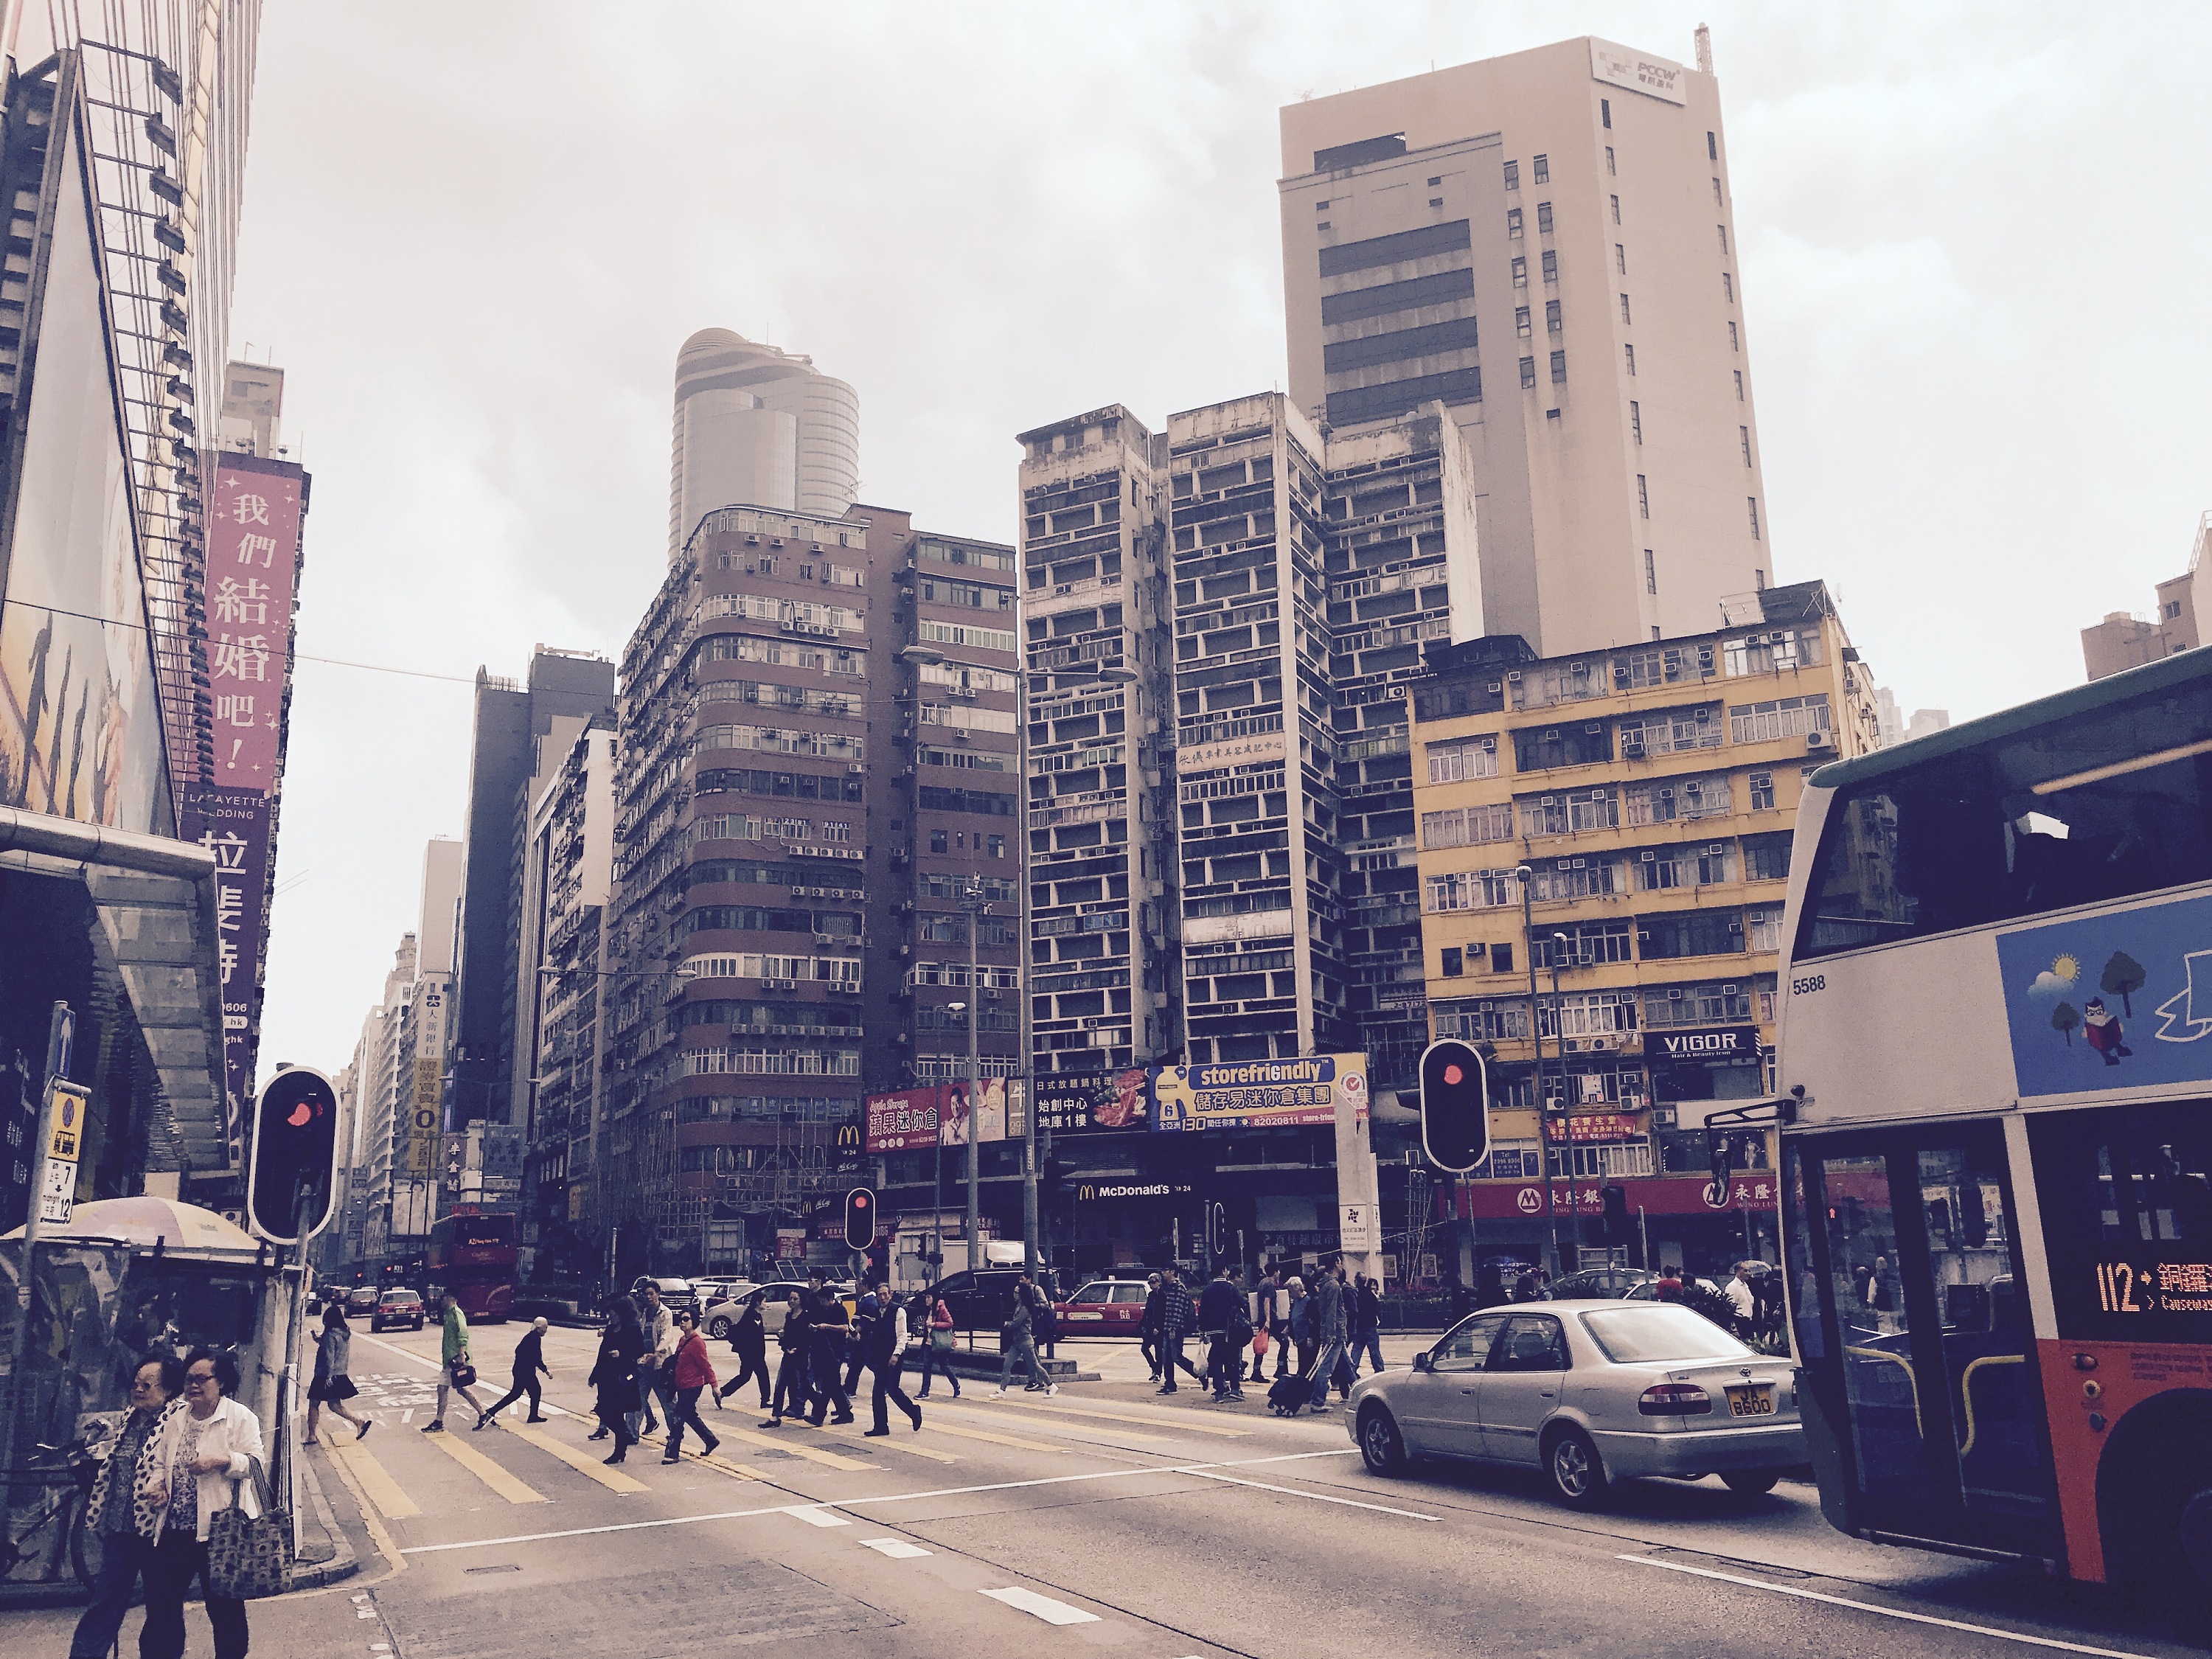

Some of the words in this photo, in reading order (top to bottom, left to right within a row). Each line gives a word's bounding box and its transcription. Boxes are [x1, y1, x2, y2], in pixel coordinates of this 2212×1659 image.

[1638, 62, 1676, 80] PCCW
[1793, 975, 1826, 995] 5588
[1663, 1033, 1737, 1052] VIGOR
[1037, 1077, 1113, 1091] 日式放題鍋料理
[1038, 1097, 1088, 1113] 始創中心
[1195, 1087, 1329, 1111] 儲存易迷你倉集團
[869, 1107, 938, 1137] 蘋果迷你倉
[1182, 1116, 1207, 1132] 130
[1253, 1116, 1298, 1126] 82020811
[65, 1166, 71, 1184] 7
[1099, 1184, 1169, 1197] McDonald's
[1735, 1183, 1778, 1200] 永隆
[60, 1198, 71, 1217] 12
[1276, 1233, 1340, 1246] 百佳超級市
[2157, 1263, 2212, 1292] 銅鑼
[2097, 1263, 2140, 1311] 112
